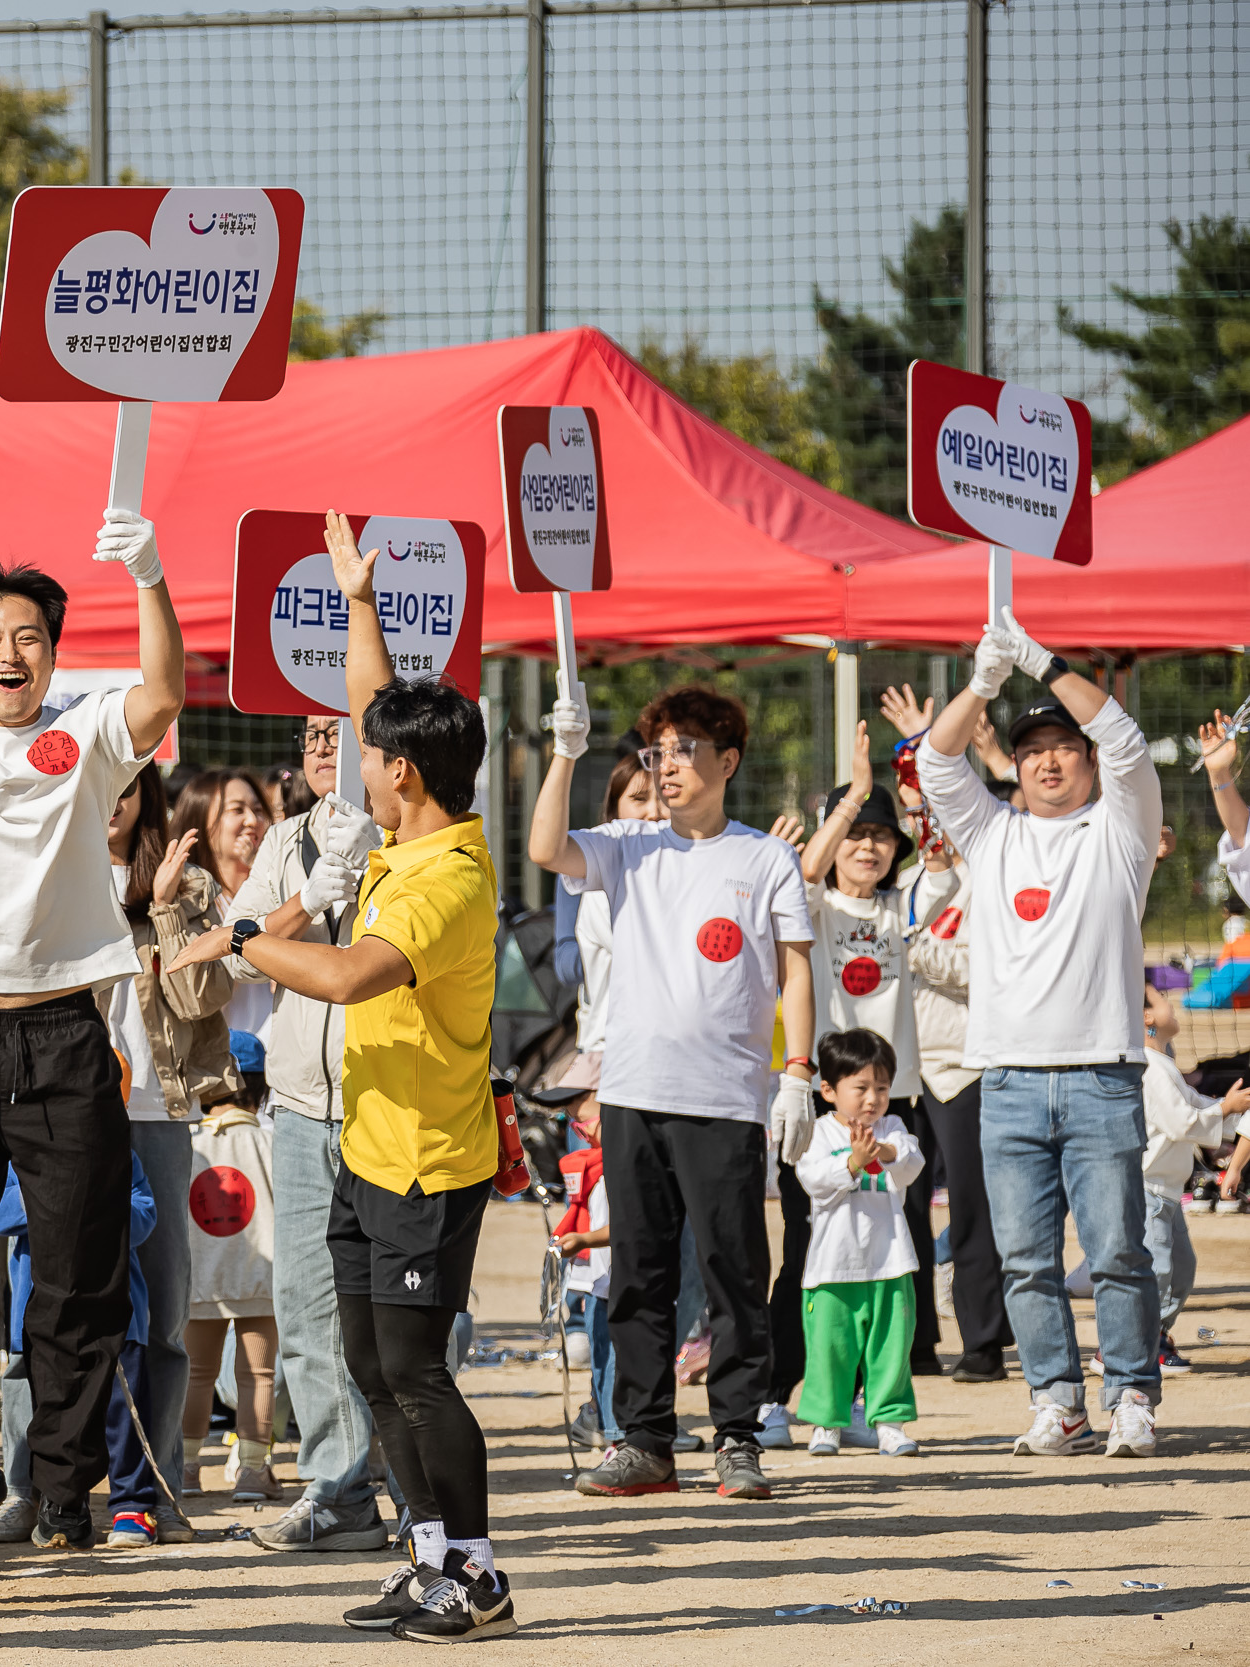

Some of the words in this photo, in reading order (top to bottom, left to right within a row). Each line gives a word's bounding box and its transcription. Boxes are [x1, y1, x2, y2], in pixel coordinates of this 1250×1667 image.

[218, 220, 256, 236] 행복광진
[53, 267, 260, 315] 늘평화어린이집
[65, 334, 232, 353] 광진구민간어린이집연합회
[942, 427, 1068, 494] 예일어린이집
[521, 474, 596, 513] 사임당어린이집
[274, 586, 454, 636] 파크빌린이집
[291, 648, 433, 672] 광진구민간연합회
